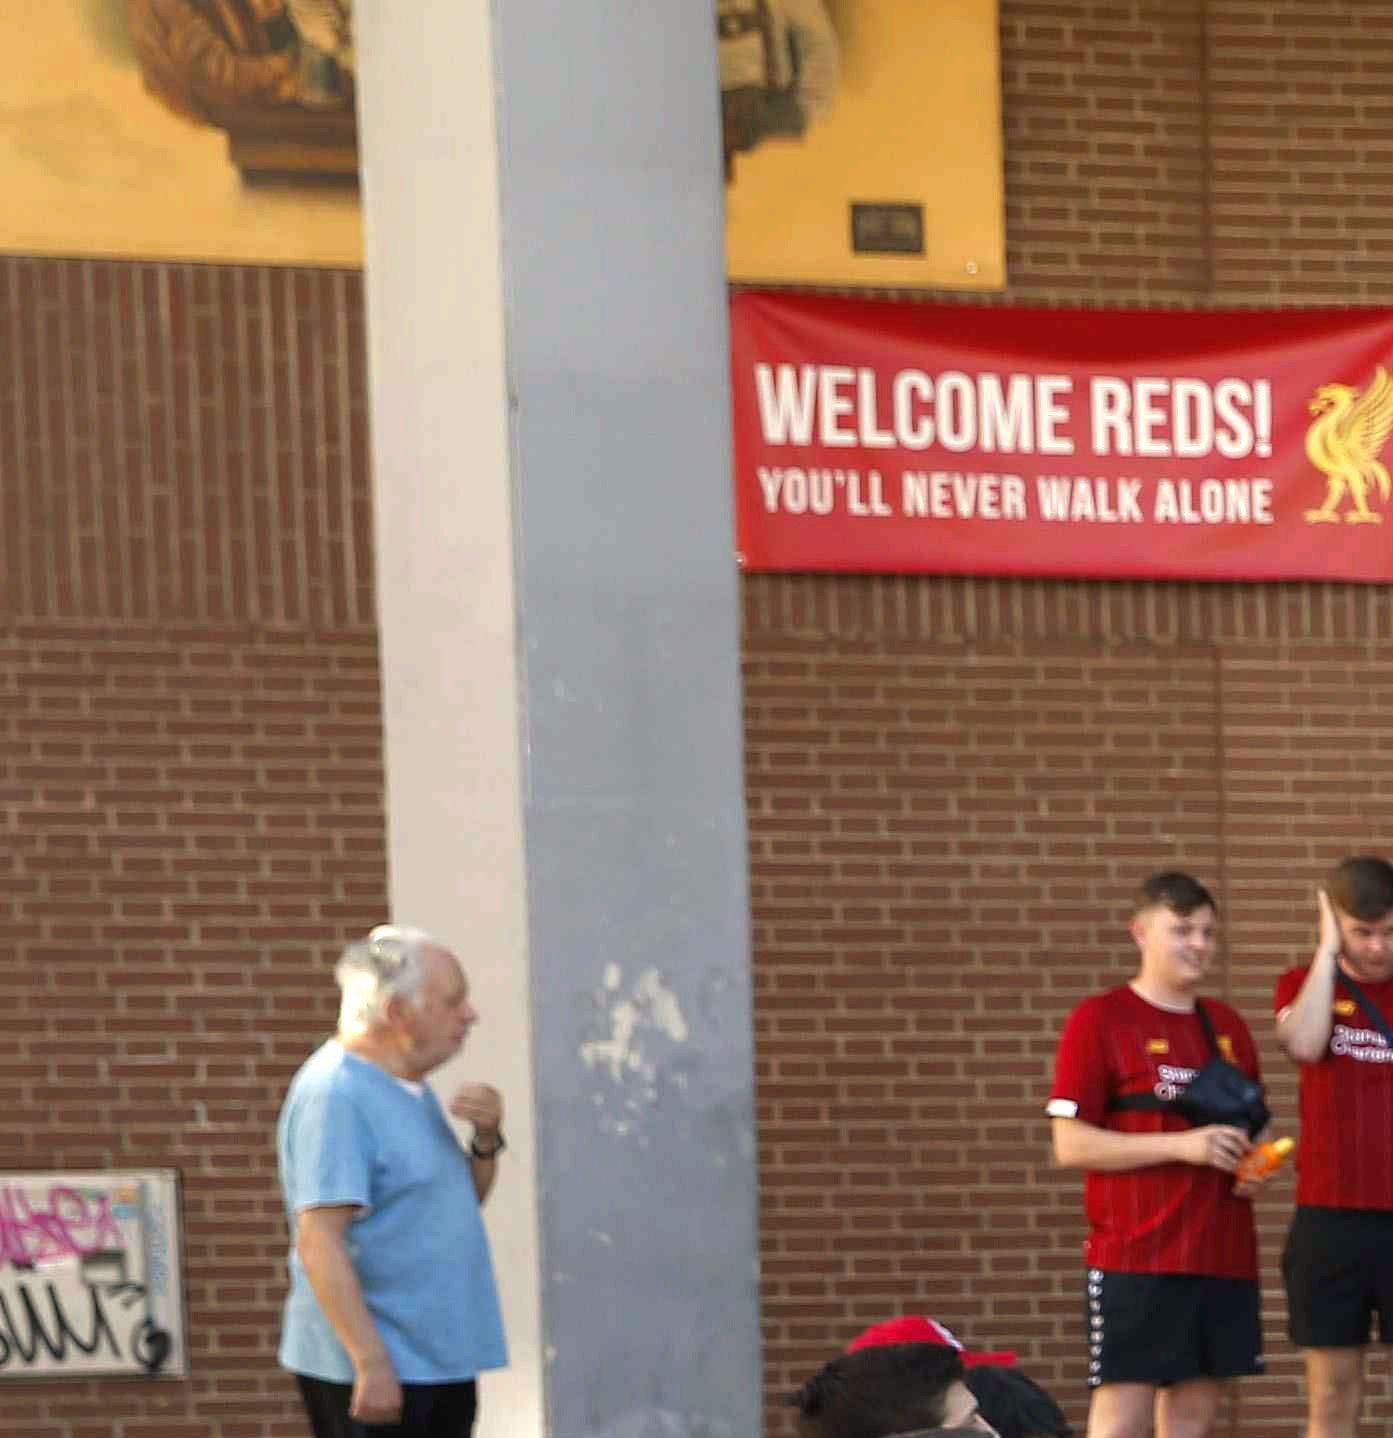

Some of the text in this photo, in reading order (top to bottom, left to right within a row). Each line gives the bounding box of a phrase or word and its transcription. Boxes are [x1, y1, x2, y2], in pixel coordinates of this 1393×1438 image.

[755, 362, 1272, 458] WELCOME REDS!
[903, 470, 1027, 520] NEVER
[1037, 475, 1144, 523] WALK
[1153, 478, 1273, 525] ALONE
